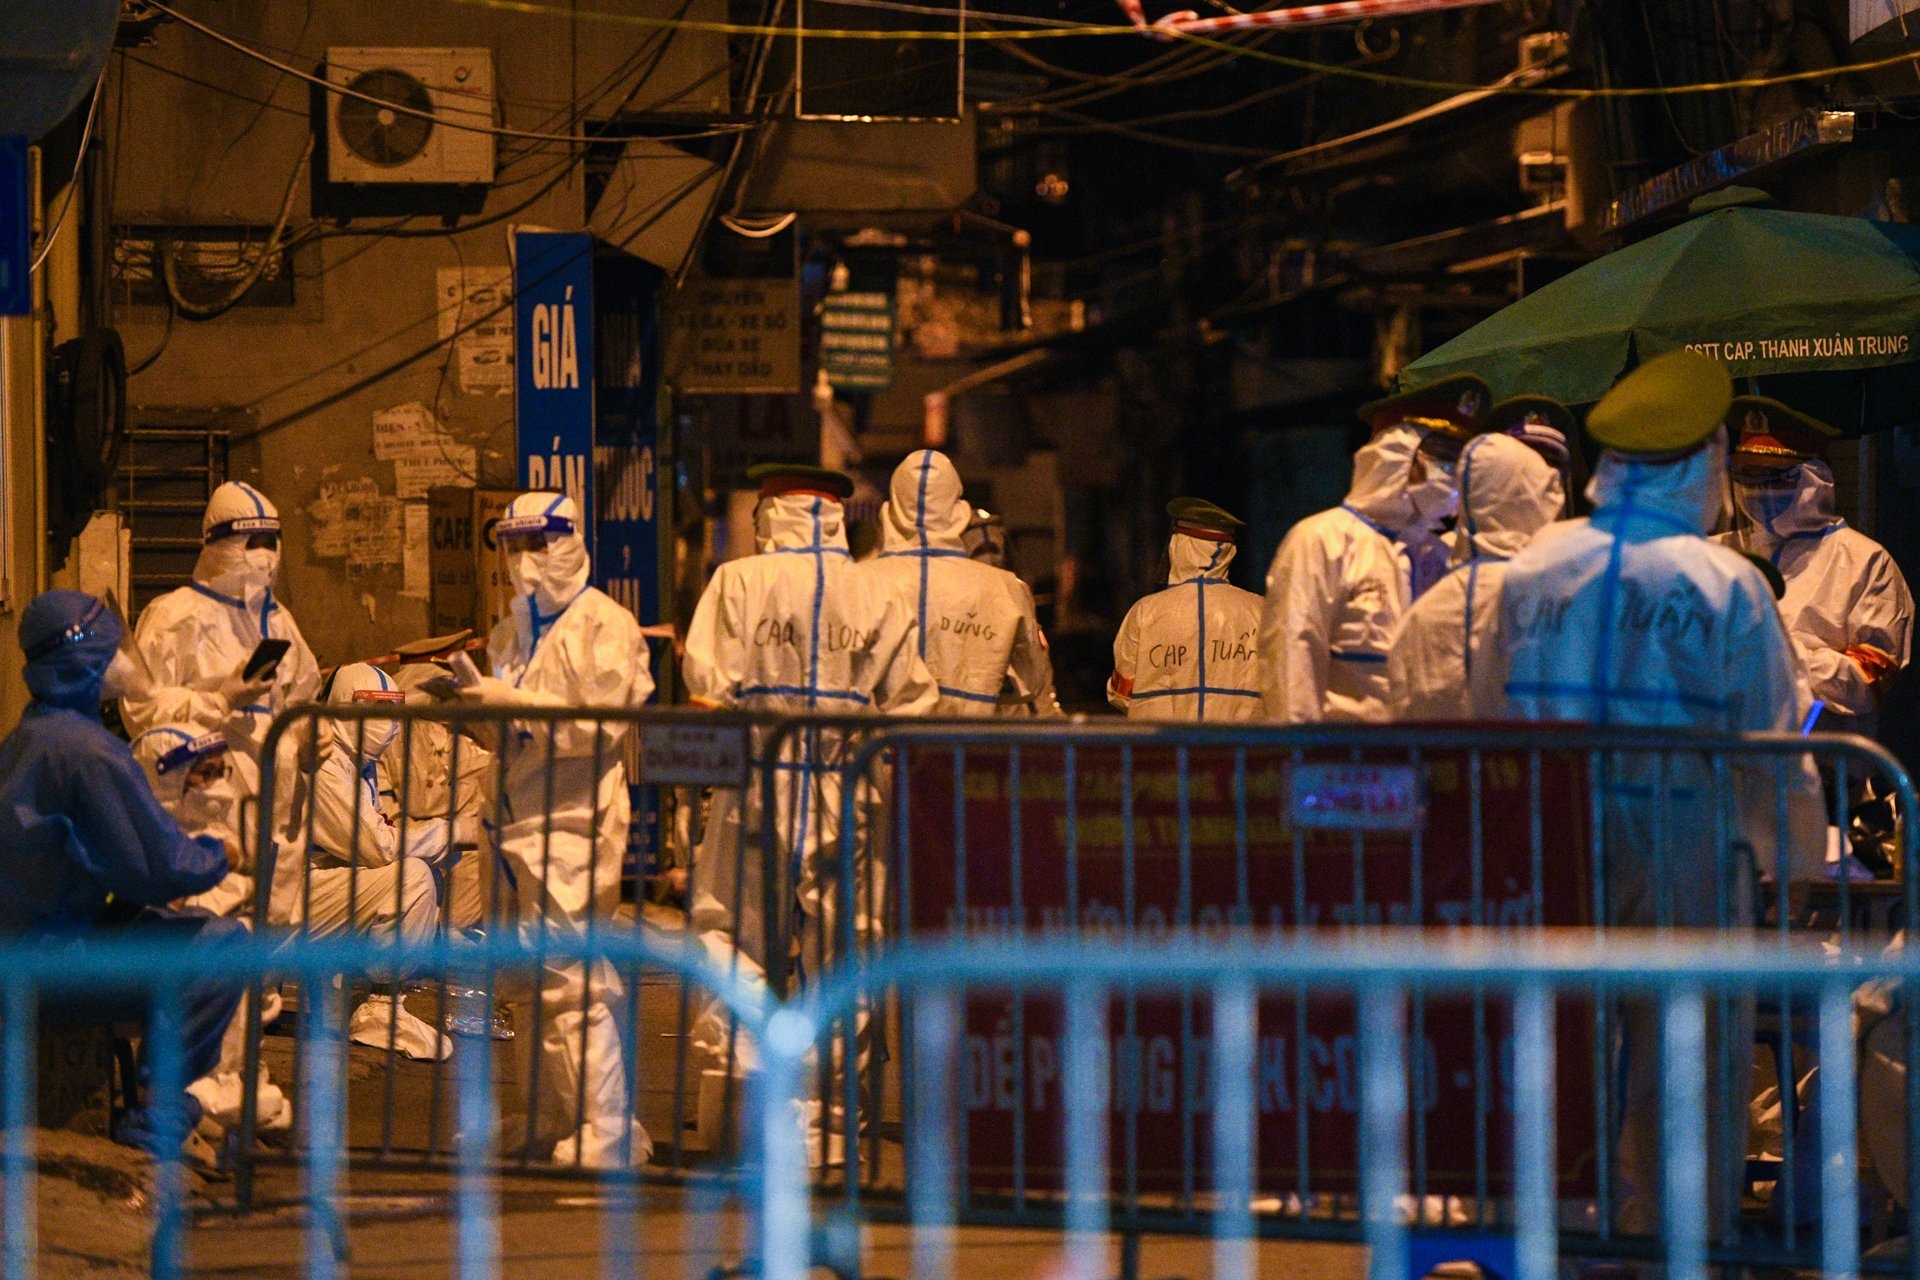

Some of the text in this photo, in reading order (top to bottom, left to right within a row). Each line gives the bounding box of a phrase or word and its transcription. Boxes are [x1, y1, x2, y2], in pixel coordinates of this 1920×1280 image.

[532, 284, 580, 390] GIÁ
[1724, 341, 1756, 361] CAP.
[1759, 337, 1809, 359] THANH
[1813, 332, 1853, 357] XUÂN
[1857, 335, 1909, 355] TRUNG
[1150, 643, 1188, 669] CAP
